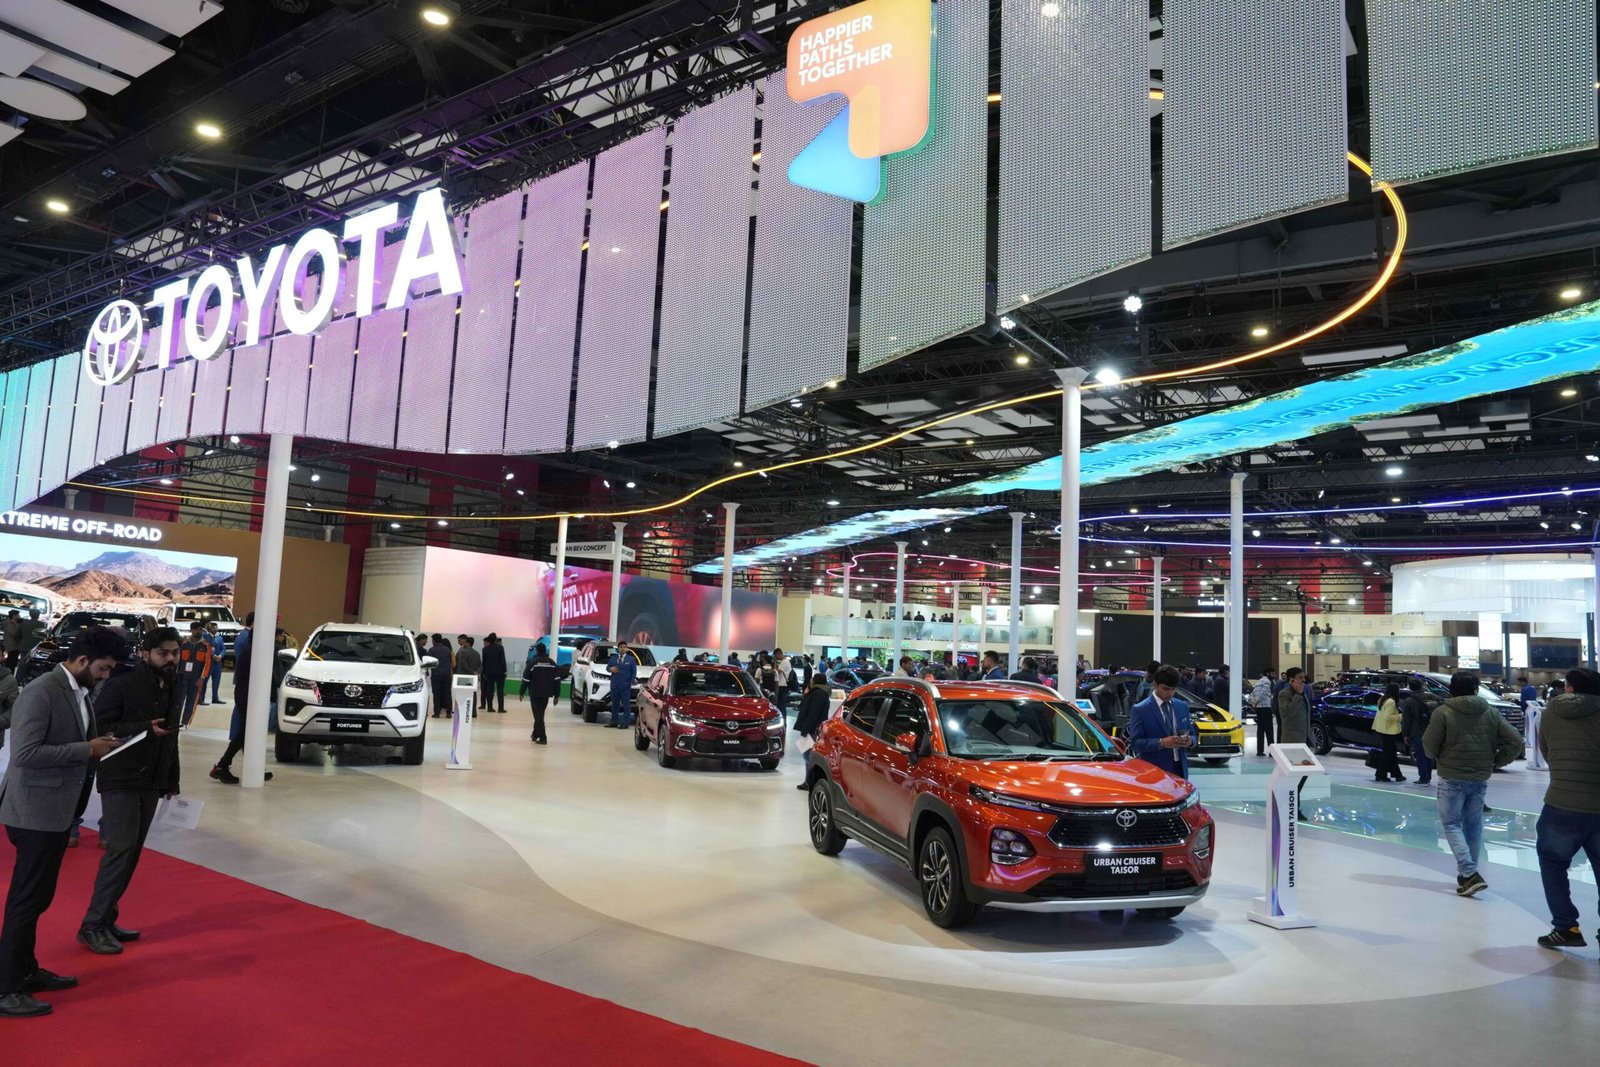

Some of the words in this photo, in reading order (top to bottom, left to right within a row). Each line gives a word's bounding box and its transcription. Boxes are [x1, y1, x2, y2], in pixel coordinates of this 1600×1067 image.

[800, 15, 873, 54] HAPPIER
[798, 42, 893, 86] TOGETHER
[799, 38, 854, 68] PATHS
[149, 186, 465, 370] TOYOTA
[1157, 419, 1285, 451] ELECTRIC
[72, 518, 162, 541] OFF-ROAD
[583, 544, 607, 552] CONCEPT
[1093, 858, 1122, 867] URBAN
[1123, 856, 1156, 865] CRUISER
[1110, 866, 1139, 874] TAISOR
